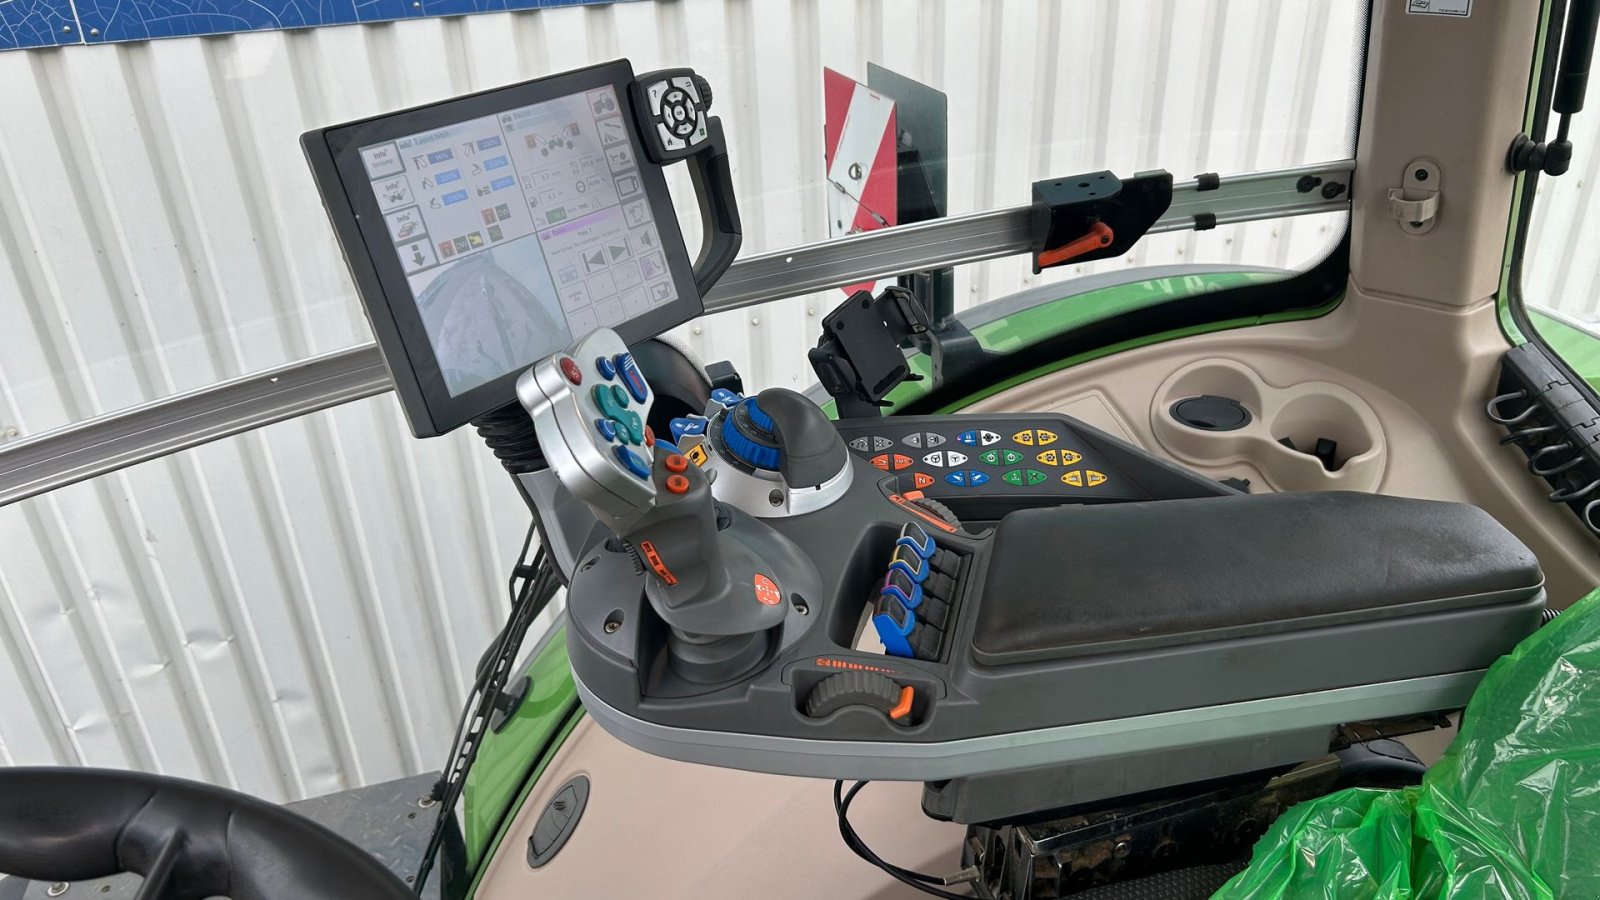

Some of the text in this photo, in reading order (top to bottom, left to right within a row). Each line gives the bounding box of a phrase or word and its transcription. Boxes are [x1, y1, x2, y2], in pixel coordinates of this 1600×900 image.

[373, 151, 388, 160] Info
[384, 182, 399, 192] Info
[396, 213, 411, 223] Info
